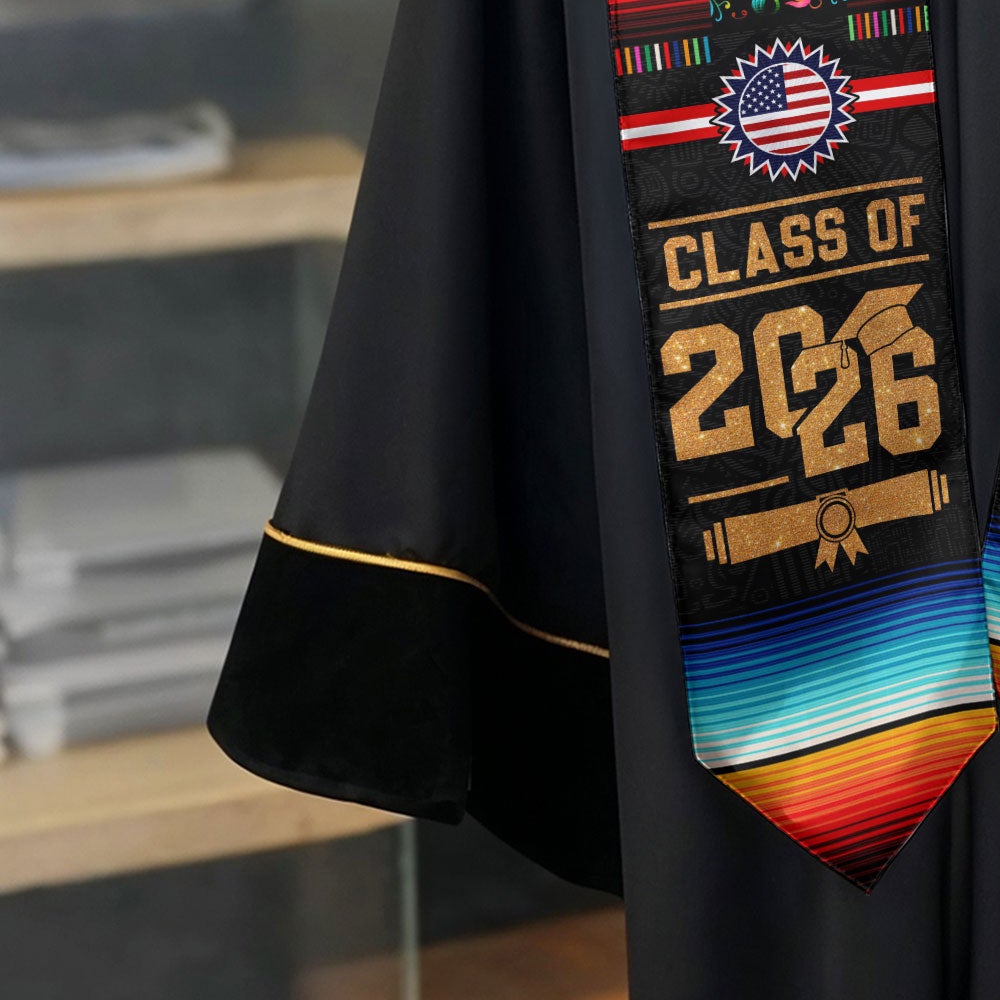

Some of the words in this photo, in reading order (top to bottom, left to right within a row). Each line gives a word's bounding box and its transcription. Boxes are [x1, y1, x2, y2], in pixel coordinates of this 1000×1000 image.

[663, 206, 849, 291] CLASS
[866, 193, 926, 252] OF
[660, 304, 942, 478] 2026
